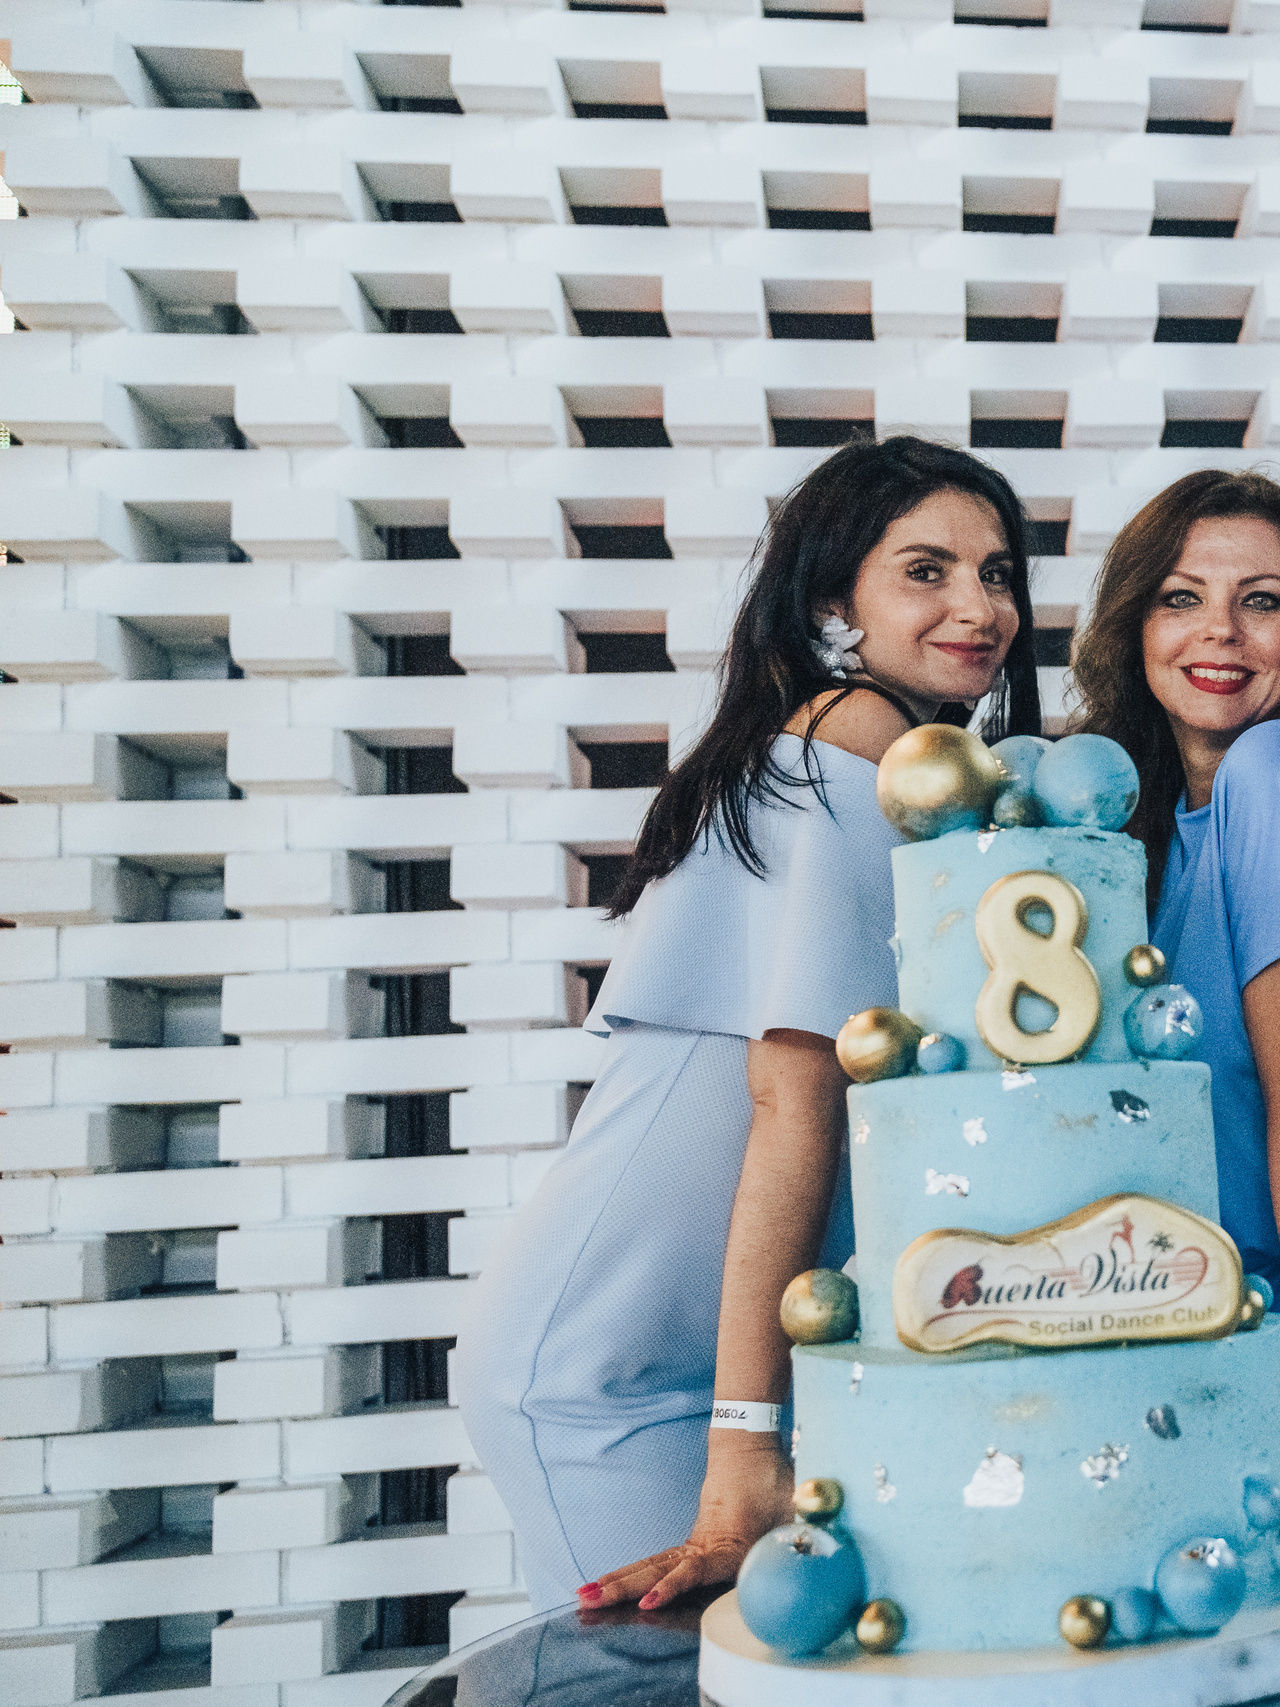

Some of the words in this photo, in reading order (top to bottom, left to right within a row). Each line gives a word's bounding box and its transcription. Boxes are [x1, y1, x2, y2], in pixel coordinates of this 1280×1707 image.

[975, 869, 1101, 1067] 8
[1079, 1247, 1170, 1298] Vista
[1029, 1315, 1094, 1335] Social
[1100, 1312, 1165, 1330] Dance
